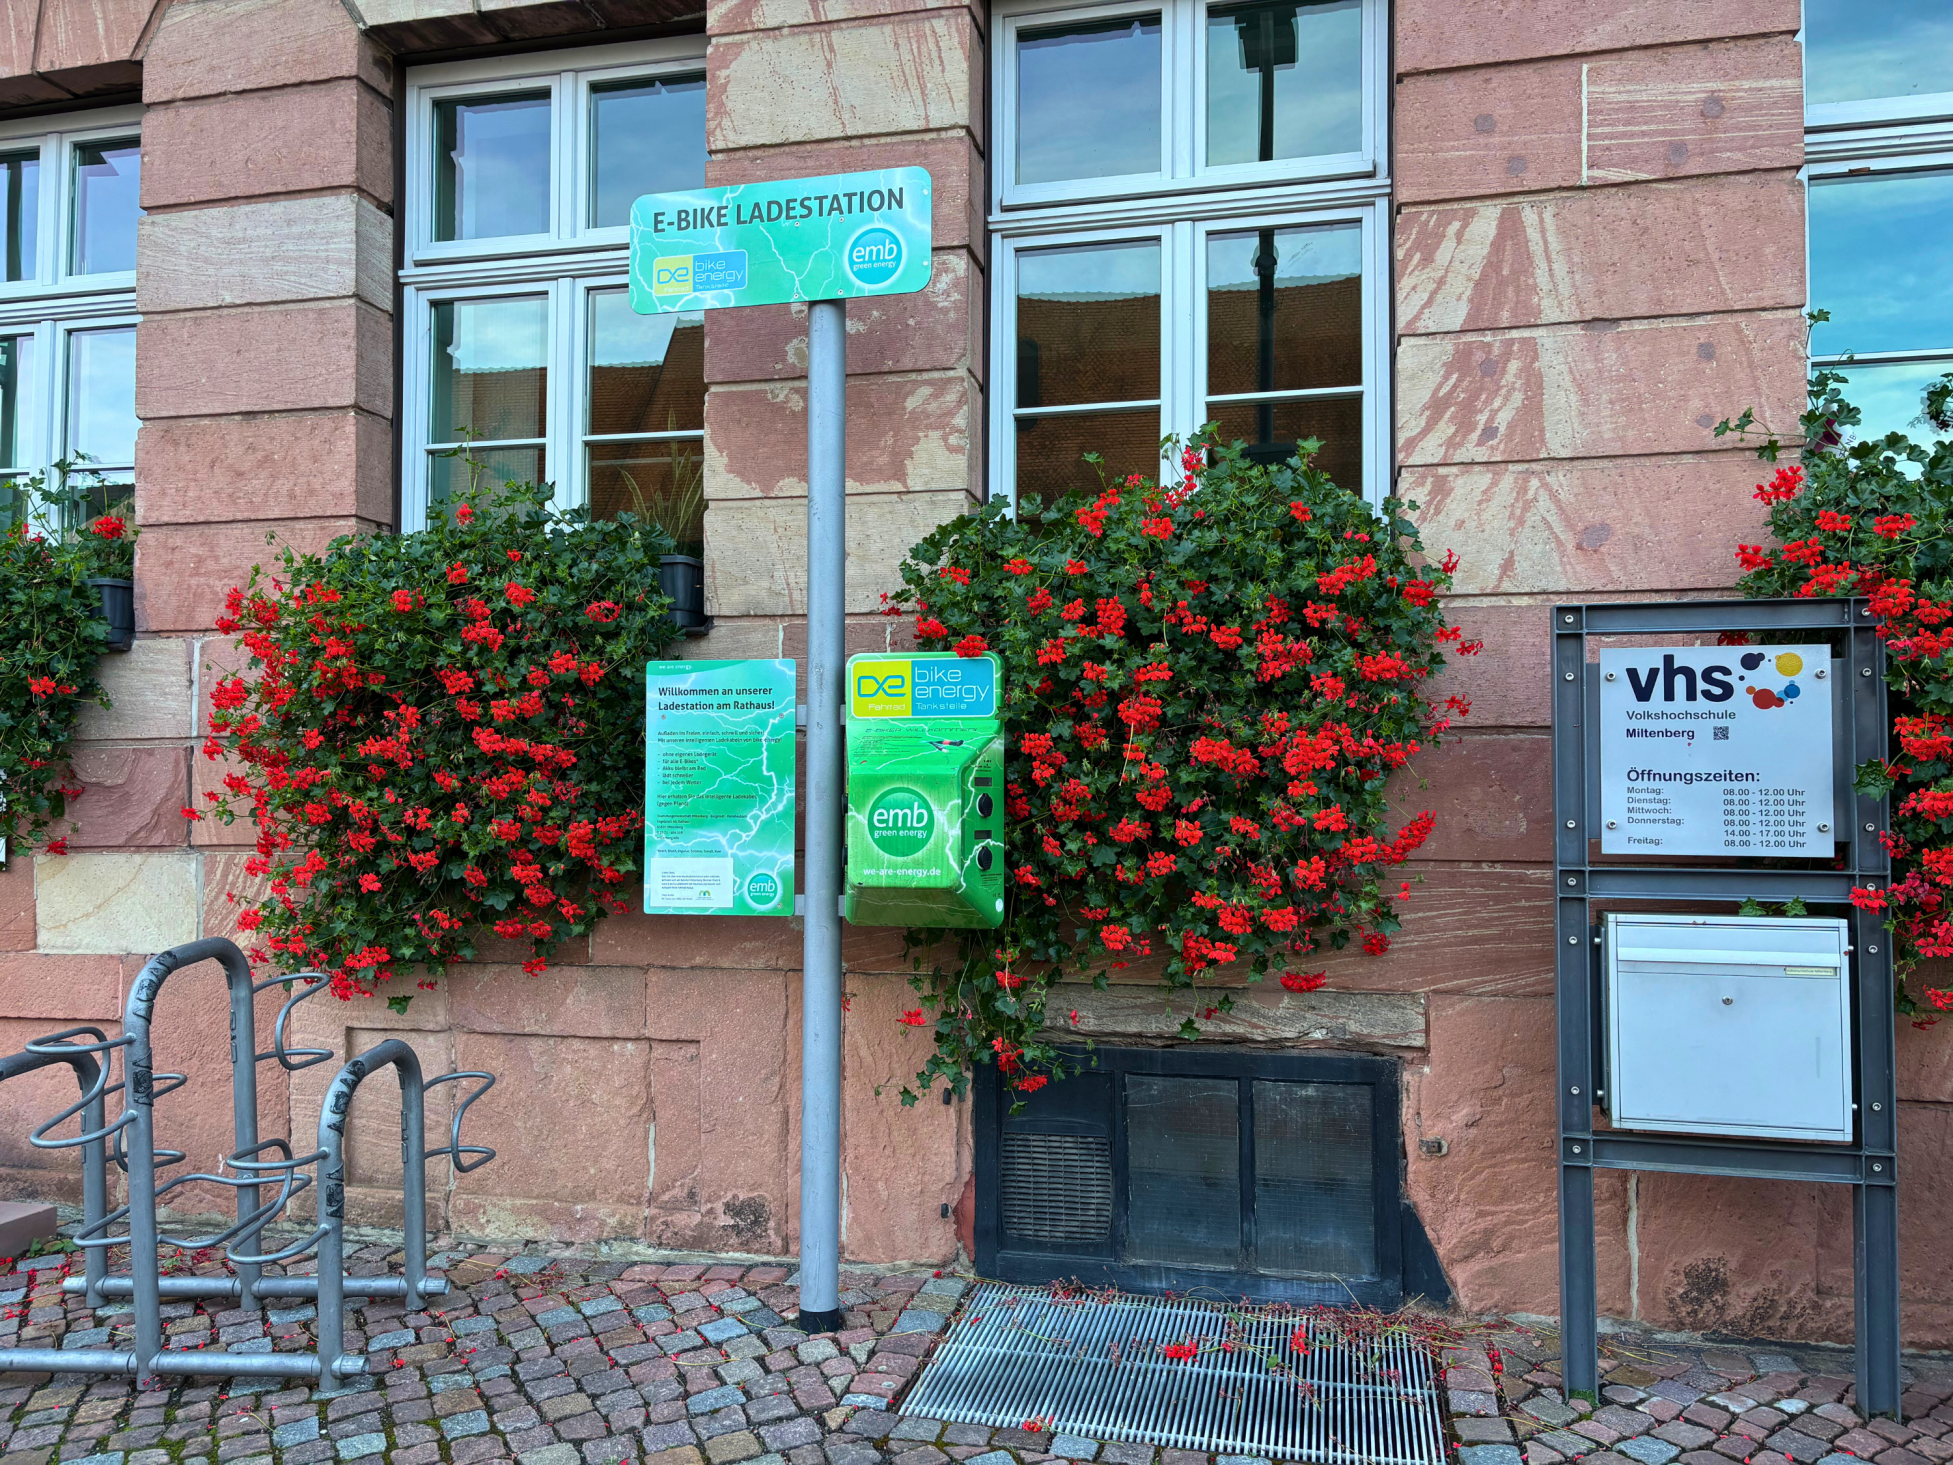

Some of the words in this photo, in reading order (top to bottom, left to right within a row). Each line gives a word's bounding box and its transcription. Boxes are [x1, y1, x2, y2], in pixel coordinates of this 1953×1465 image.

[654, 205, 728, 234] E-BIKE
[736, 187, 904, 225] LADESTATION
[852, 239, 897, 262] emb
[695, 260, 725, 271] bike
[853, 262, 873, 270] green
[874, 260, 896, 269] energy
[695, 269, 744, 282] energy
[915, 666, 962, 682] bike
[1626, 653, 1734, 702] vhs
[658, 687, 720, 696] Willkommen
[736, 687, 772, 695] unserer
[915, 684, 990, 701] energy
[658, 701, 714, 711] Ladestation
[716, 702, 731, 710] am
[733, 701, 775, 710] Rathaus!
[916, 702, 967, 710] Tankstelle
[1626, 710, 1736, 721] Volkshochschule
[1626, 728, 1695, 740] Miltenberg
[1627, 767, 1760, 785] Öffnungszeiten:
[1627, 786, 1664, 795] Montag:
[1723, 788, 1750, 797] 08.00
[1759, 788, 1784, 797] 12.00
[1787, 788, 1805, 797] Uhr
[1627, 797, 1671, 805] Dienstag:
[1723, 799, 1750, 807] 08.00
[1759, 799, 1785, 807] 12.00
[1787, 799, 1805, 807] Uhr
[873, 802, 928, 828] emb
[1627, 806, 1672, 814] Mittwoch:
[1723, 809, 1750, 817] 08.00
[1759, 809, 1785, 817] 12.00
[1787, 809, 1806, 817] Uhr
[1627, 816, 1685, 826] Donnerstag:
[1723, 819, 1750, 828] 08.00
[1759, 819, 1785, 828] 12.00
[1788, 819, 1806, 828] Uhr
[874, 829, 898, 838] green
[899, 829, 928, 839] energy
[1724, 830, 1751, 838] 14.00
[1759, 830, 1785, 838] 17.00
[1788, 830, 1806, 838] Uhr
[1628, 836, 1663, 846] Freitag:
[1724, 840, 1751, 848] 08.00
[1760, 840, 1785, 848] 12.00
[1788, 840, 1806, 848] Uhr
[863, 868, 941, 878] we-are-energy.de
[750, 880, 775, 892] emb
